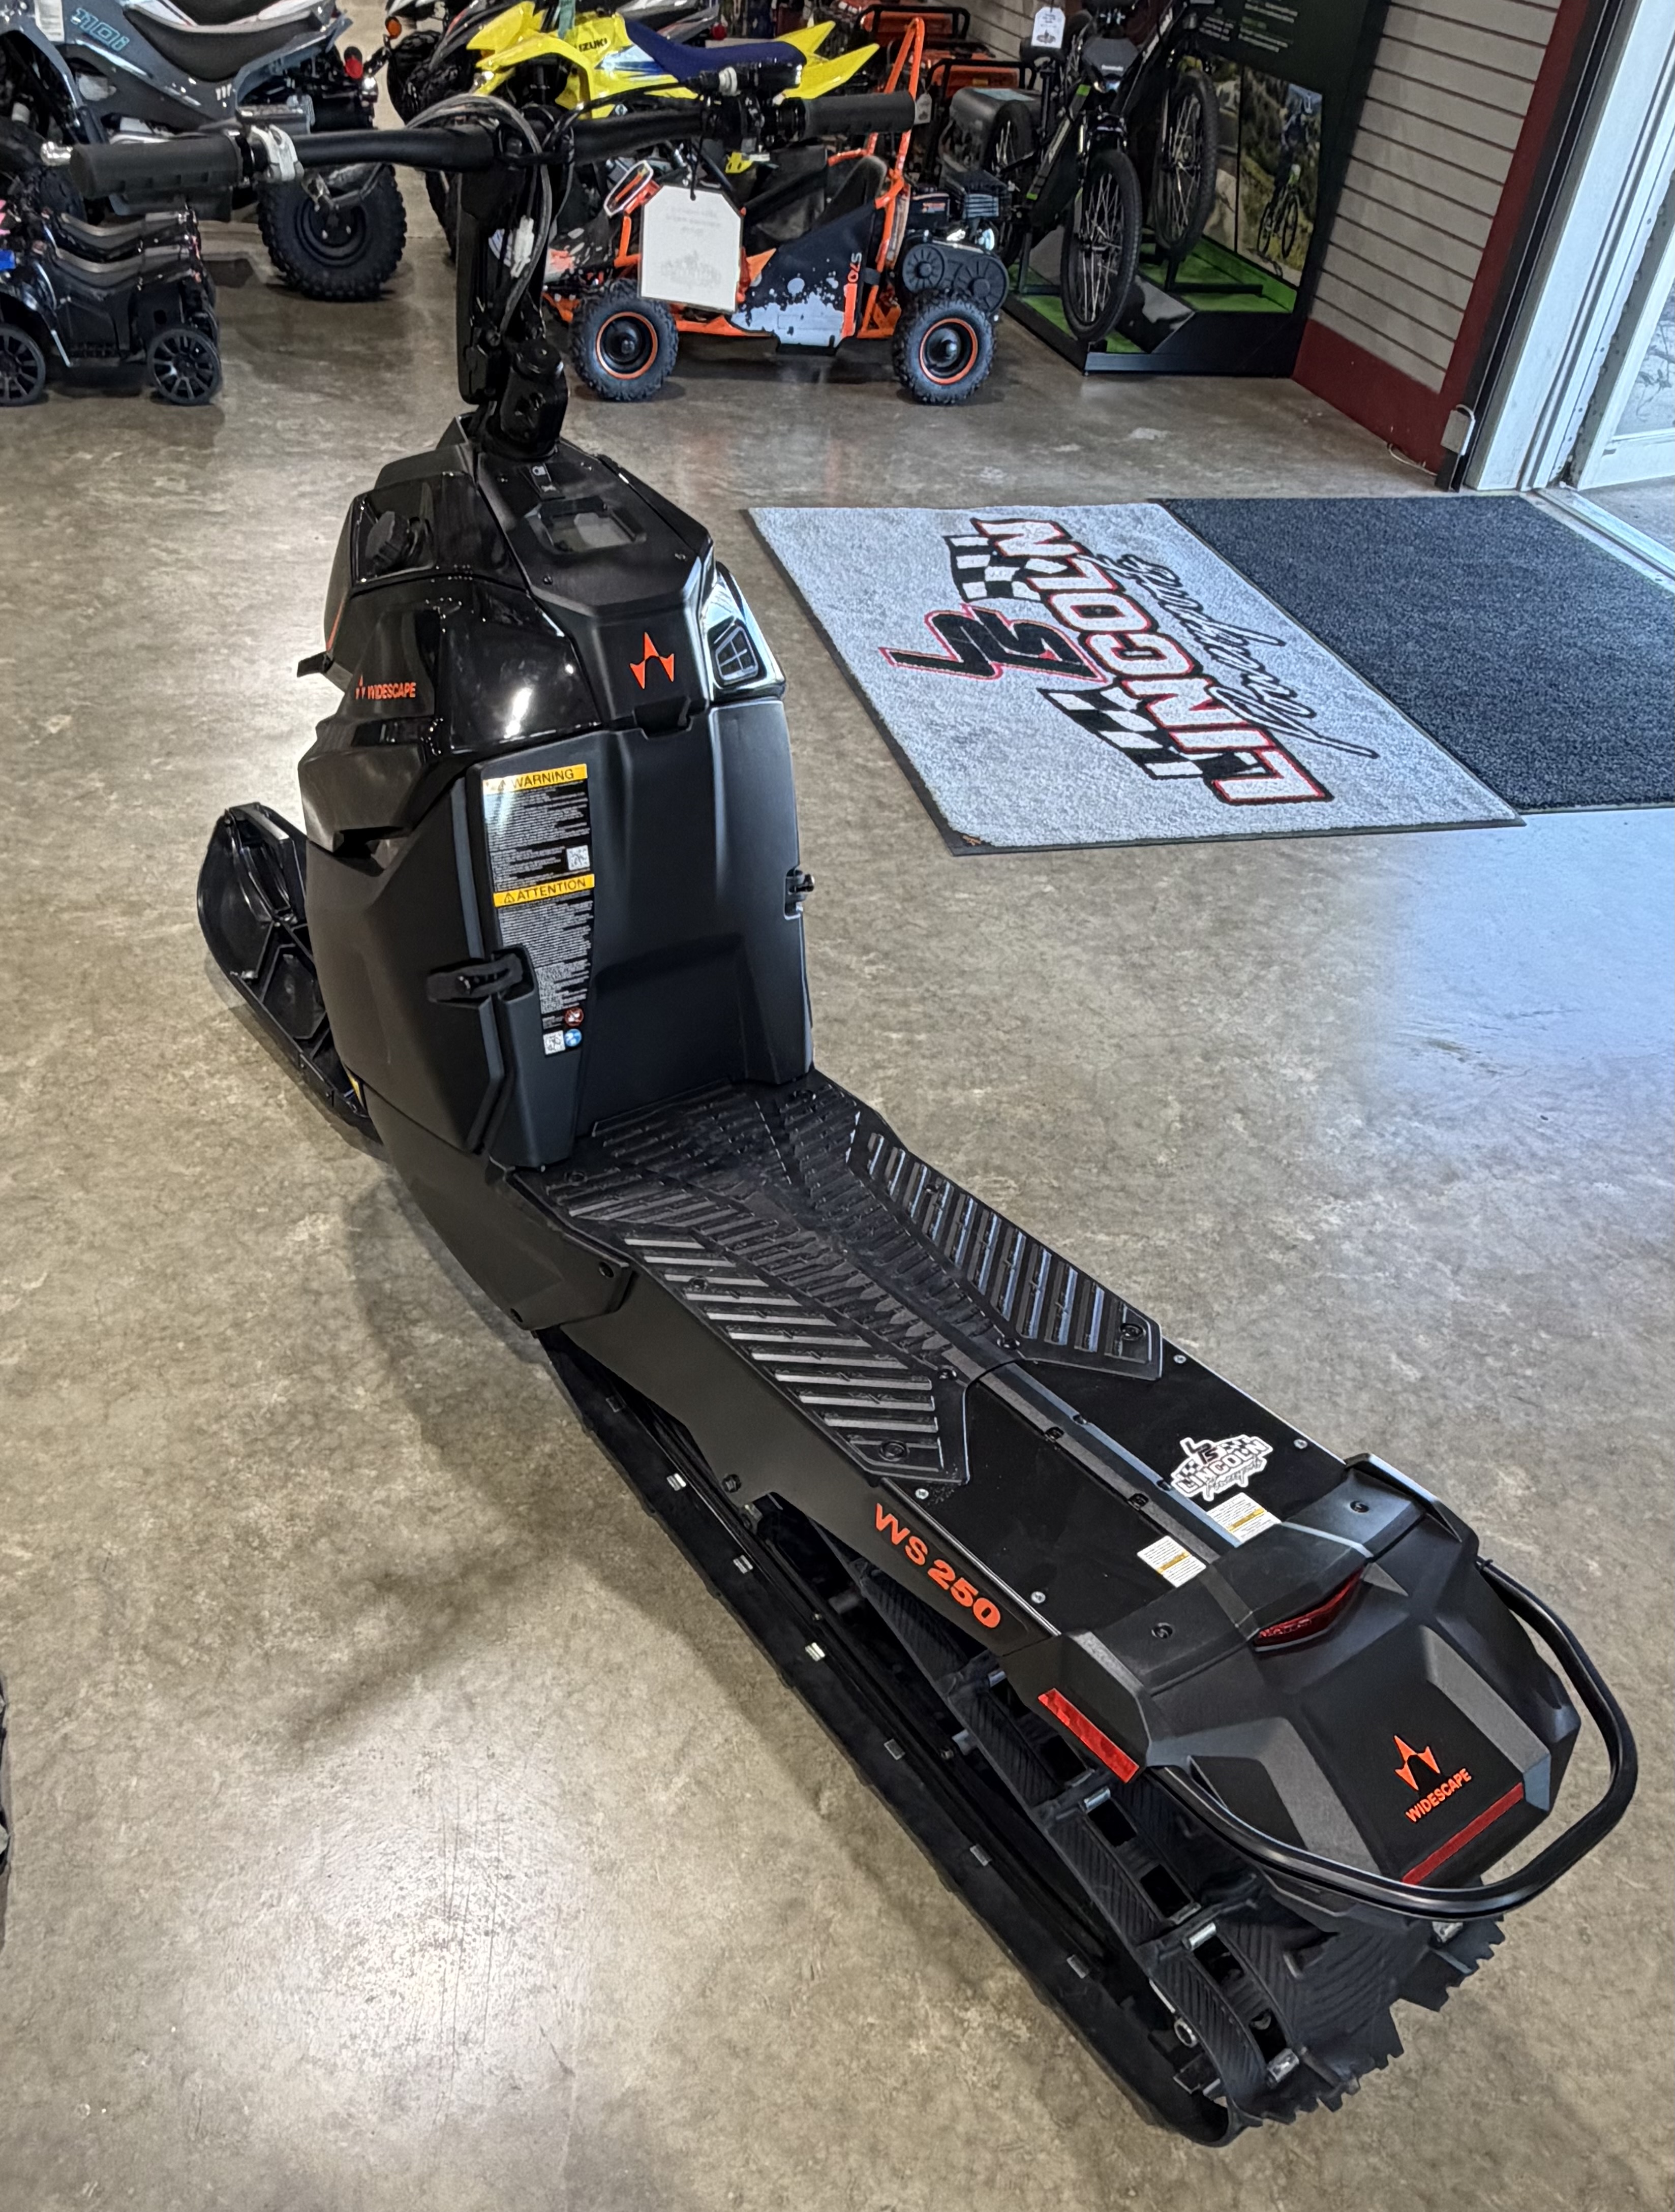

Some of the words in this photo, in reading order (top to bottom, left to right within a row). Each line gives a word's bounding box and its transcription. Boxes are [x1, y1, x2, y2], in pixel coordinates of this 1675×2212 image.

[578, 38, 607, 52] ZUKI
[969, 517, 1335, 806] LINCOLN
[1073, 553, 1380, 759] Powersports
[368, 682, 416, 700] WIDESCAPE
[511, 768, 574, 789] WARNING
[517, 878, 586, 901] ATTENTION
[1175, 1438, 1270, 1494] LINCOLN
[875, 1502, 928, 1566] WS
[927, 1559, 1001, 1629] 250
[1405, 1768, 1473, 1823] WIDESCAPE
